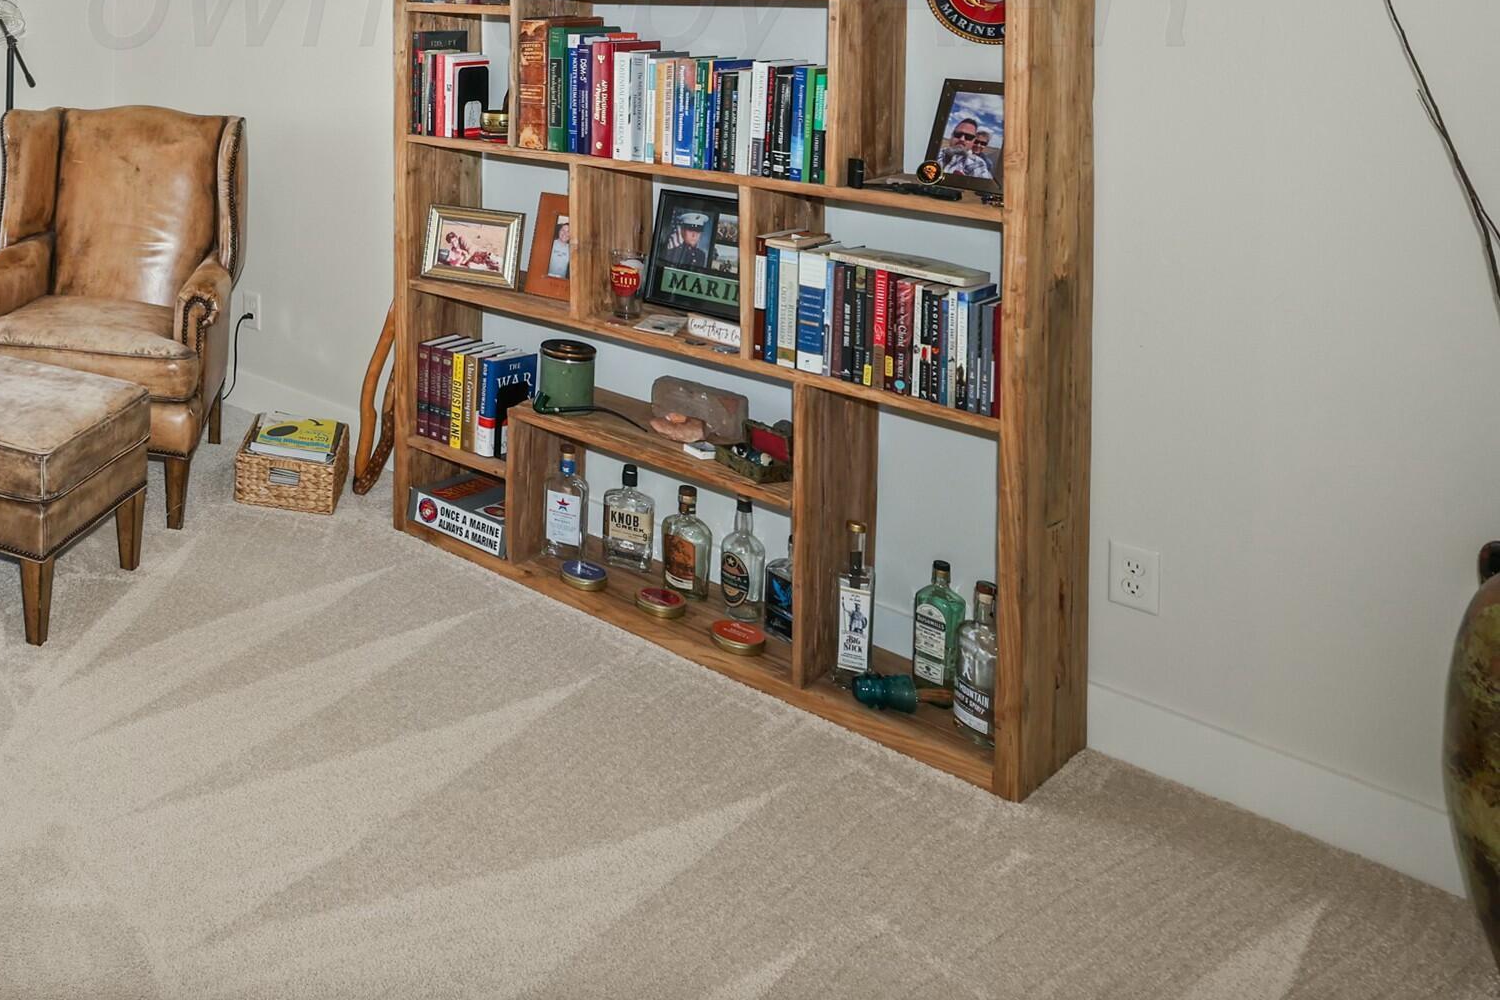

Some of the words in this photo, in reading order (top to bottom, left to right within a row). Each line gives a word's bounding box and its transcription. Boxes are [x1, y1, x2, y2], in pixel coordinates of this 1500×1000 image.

[941, 2, 996, 37] MARINE
[678, 65, 686, 112] Psychotherapeutic
[600, 93, 608, 126] Dictionary
[618, 97, 626, 145] PSYCHOTHERAPY
[875, 280, 885, 315] CELEBRATION
[780, 303, 788, 344] TESTAMENT
[787, 303, 795, 345] RELIABILITY
[897, 324, 907, 348] Christ
[466, 361, 475, 380] Alan
[496, 371, 533, 388] WAR
[509, 362, 521, 371] THE
[451, 380, 462, 410] GHOST
[463, 381, 474, 423] Greenspan
[450, 411, 461, 441] PLANE
[440, 506, 460, 522] ONCE
[461, 515, 467, 525] A
[469, 518, 500, 538] MARINE
[610, 510, 640, 528] KNOB
[615, 523, 644, 534] CREEK
[438, 518, 463, 537] ALWAYS
[464, 529, 470, 539] A
[471, 531, 498, 551] MARINE
[916, 614, 946, 630] BUSHMILLS
[843, 643, 863, 654] STICK
[845, 635, 861, 645] BIG
[958, 682, 990, 709] MOUNTAIN
